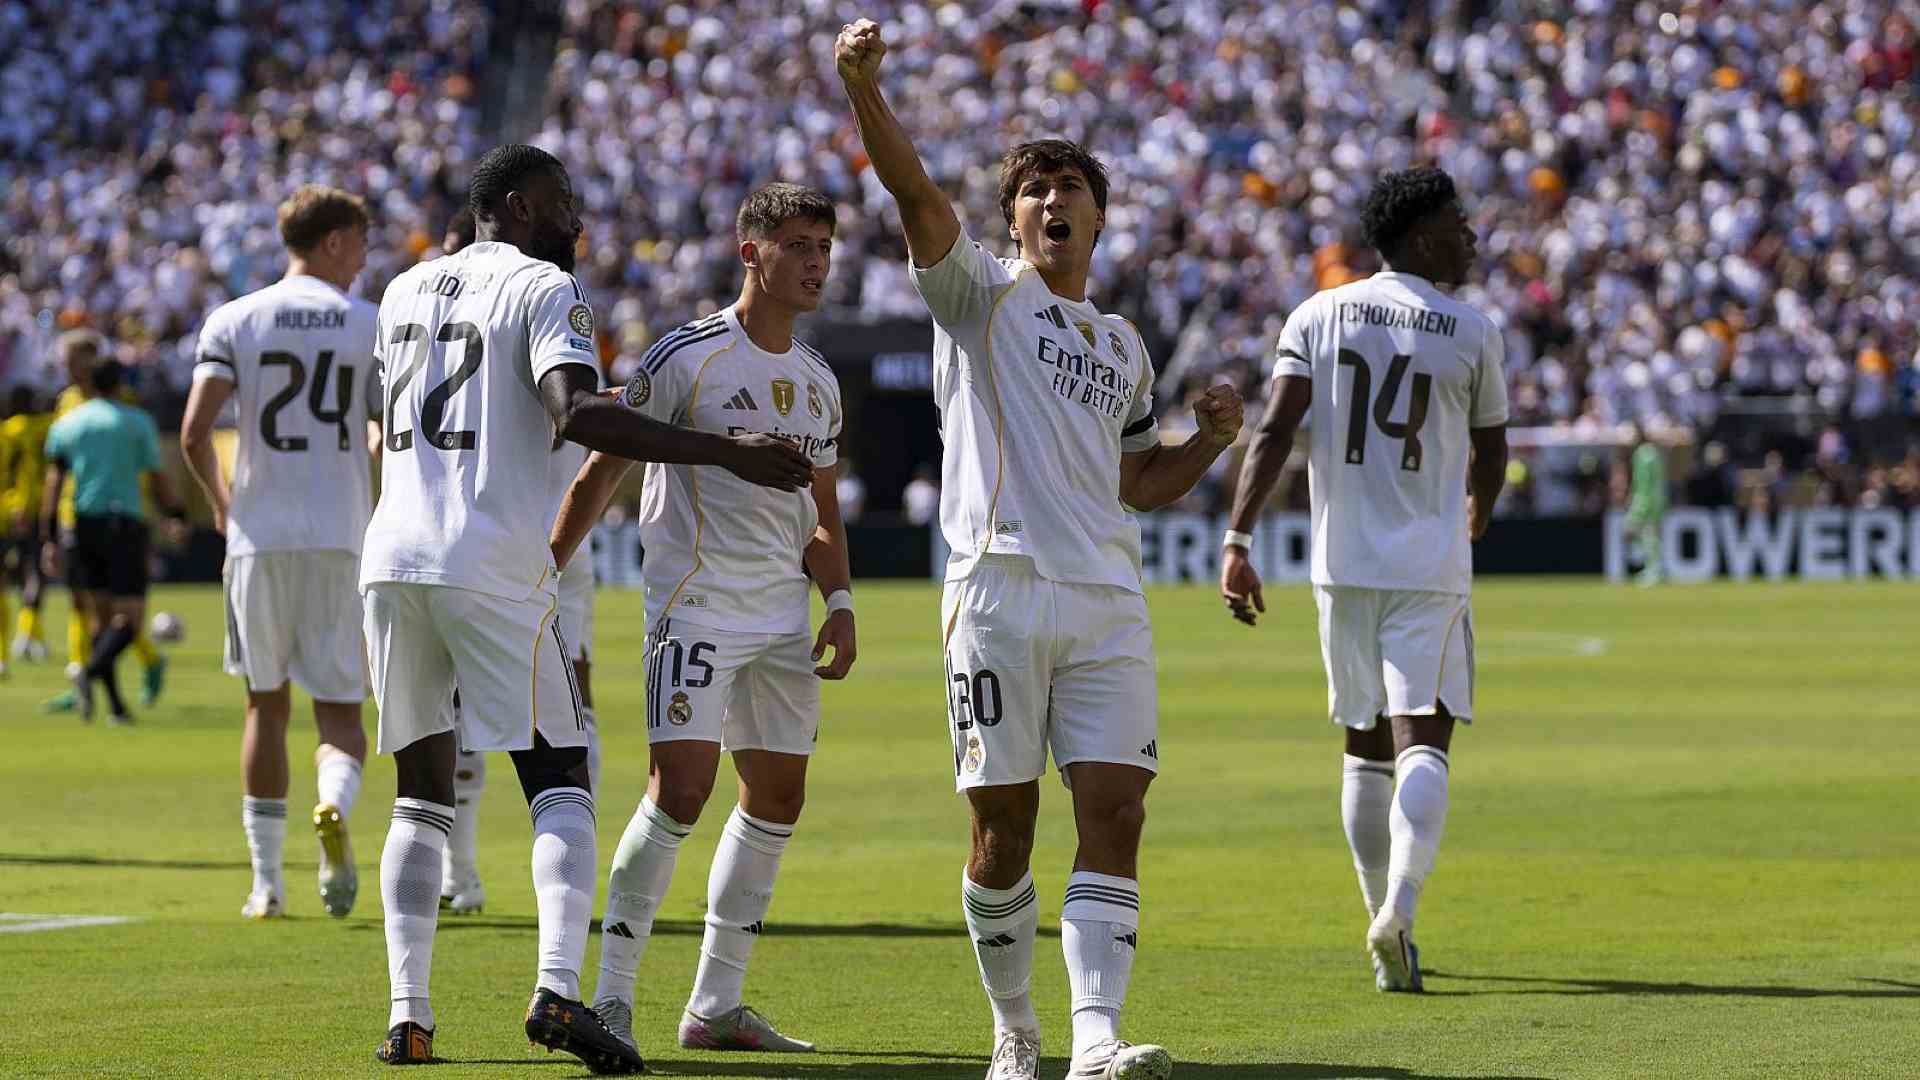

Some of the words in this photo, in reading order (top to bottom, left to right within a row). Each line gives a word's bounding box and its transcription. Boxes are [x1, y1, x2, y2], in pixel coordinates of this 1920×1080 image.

[259, 350, 353, 451] 24
[387, 321, 484, 452] 22
[1053, 373, 1079, 399] FLY
[1339, 349, 1433, 472] 14
[668, 639, 717, 688] 15
[954, 669, 1003, 731] 30
